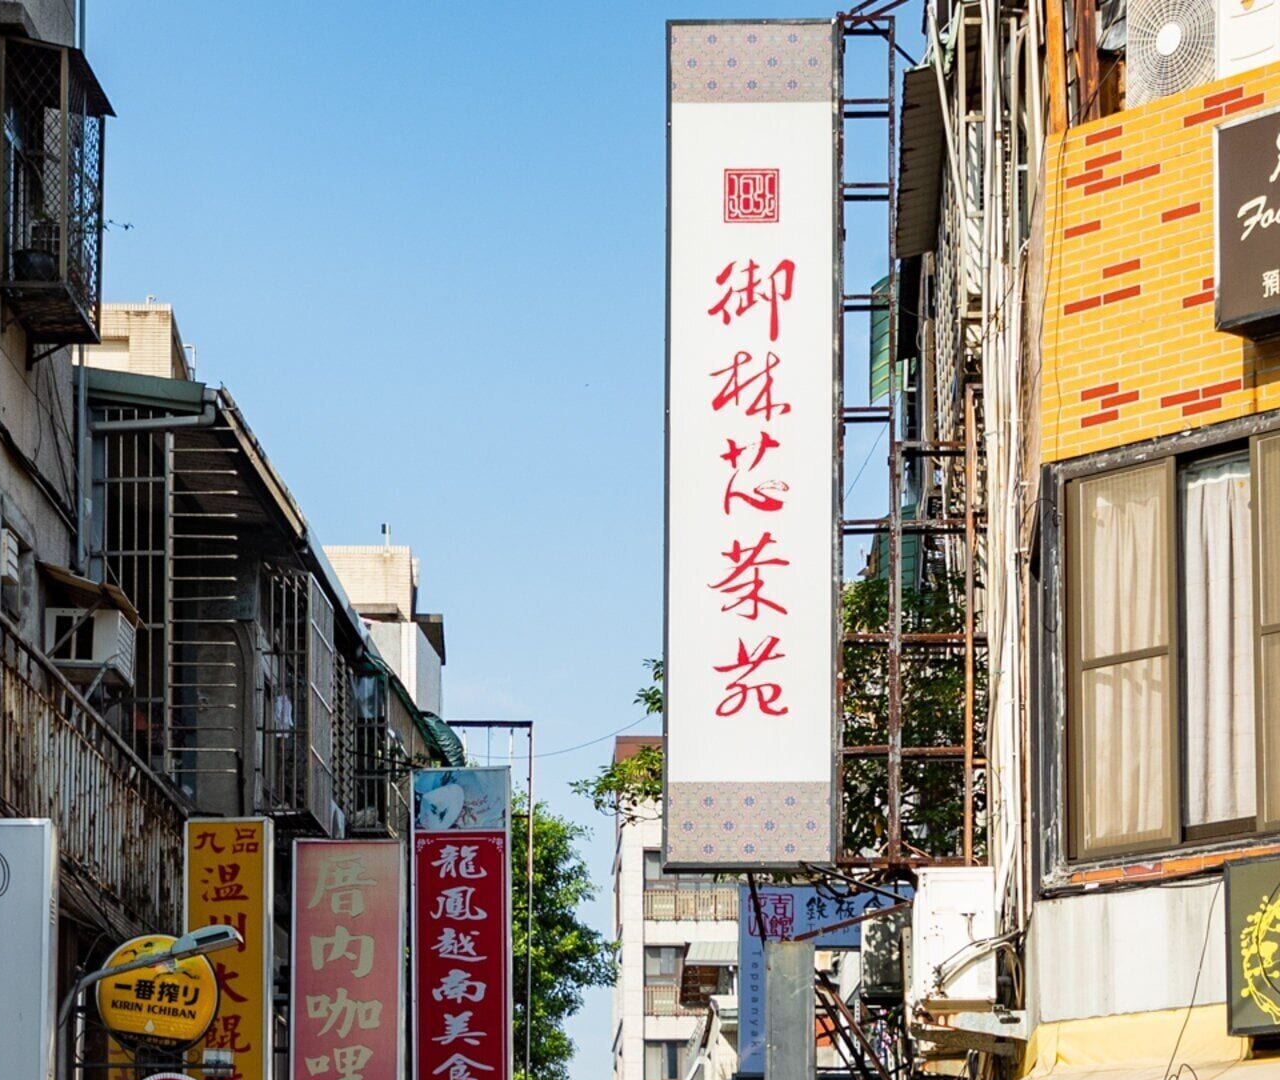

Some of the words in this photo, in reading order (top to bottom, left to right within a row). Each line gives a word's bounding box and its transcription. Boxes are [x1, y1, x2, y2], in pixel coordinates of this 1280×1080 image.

[194, 828, 259, 854] 九品
[114, 979, 200, 1006] 一番搾り
[749, 950, 762, 1058] Teppanyaki
[111, 1000, 143, 1012] KIRIN
[147, 1004, 197, 1020] ICHIBAN
